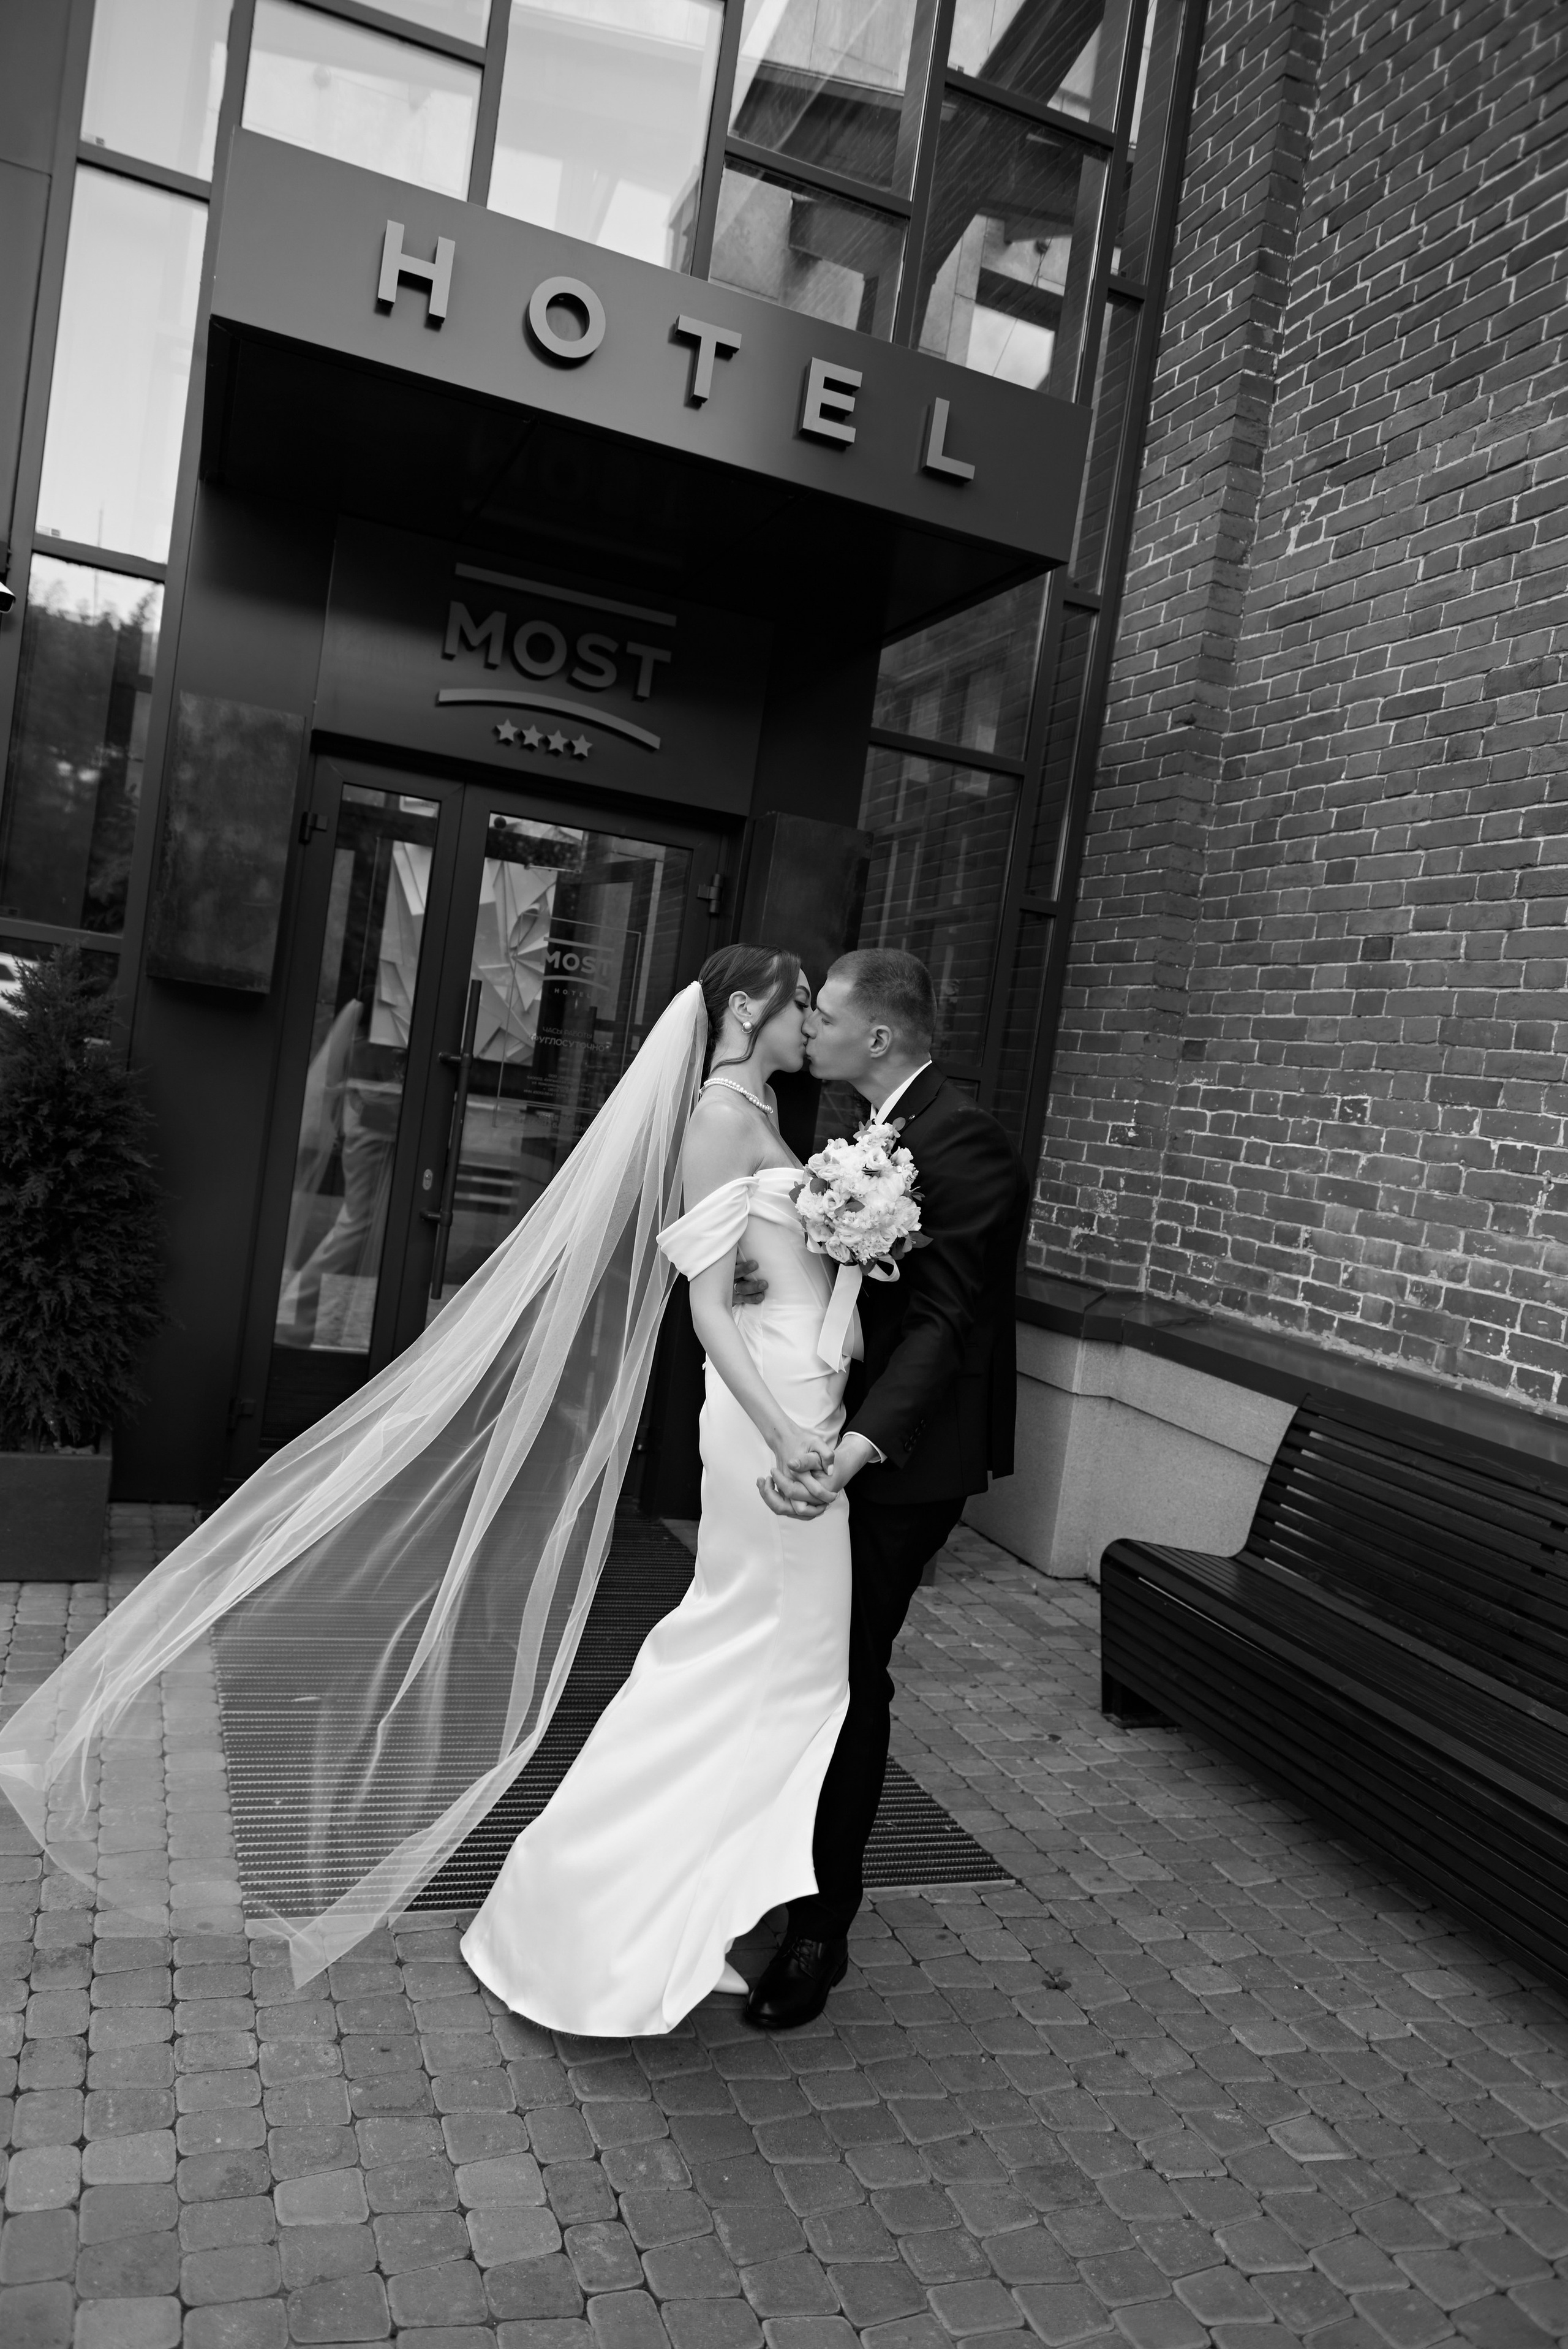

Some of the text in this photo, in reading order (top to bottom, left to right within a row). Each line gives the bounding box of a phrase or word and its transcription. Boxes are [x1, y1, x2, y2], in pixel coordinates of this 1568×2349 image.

[376, 220, 975, 483] HOTEL
[442, 601, 672, 699] MOST
[541, 949, 612, 976] MOST
[554, 987, 591, 998] HOTEL
[527, 1034, 605, 1052] КРУГЛОСУТОЧНО
[543, 1026, 592, 1039] ЧАСЫ РАБОТЫ
